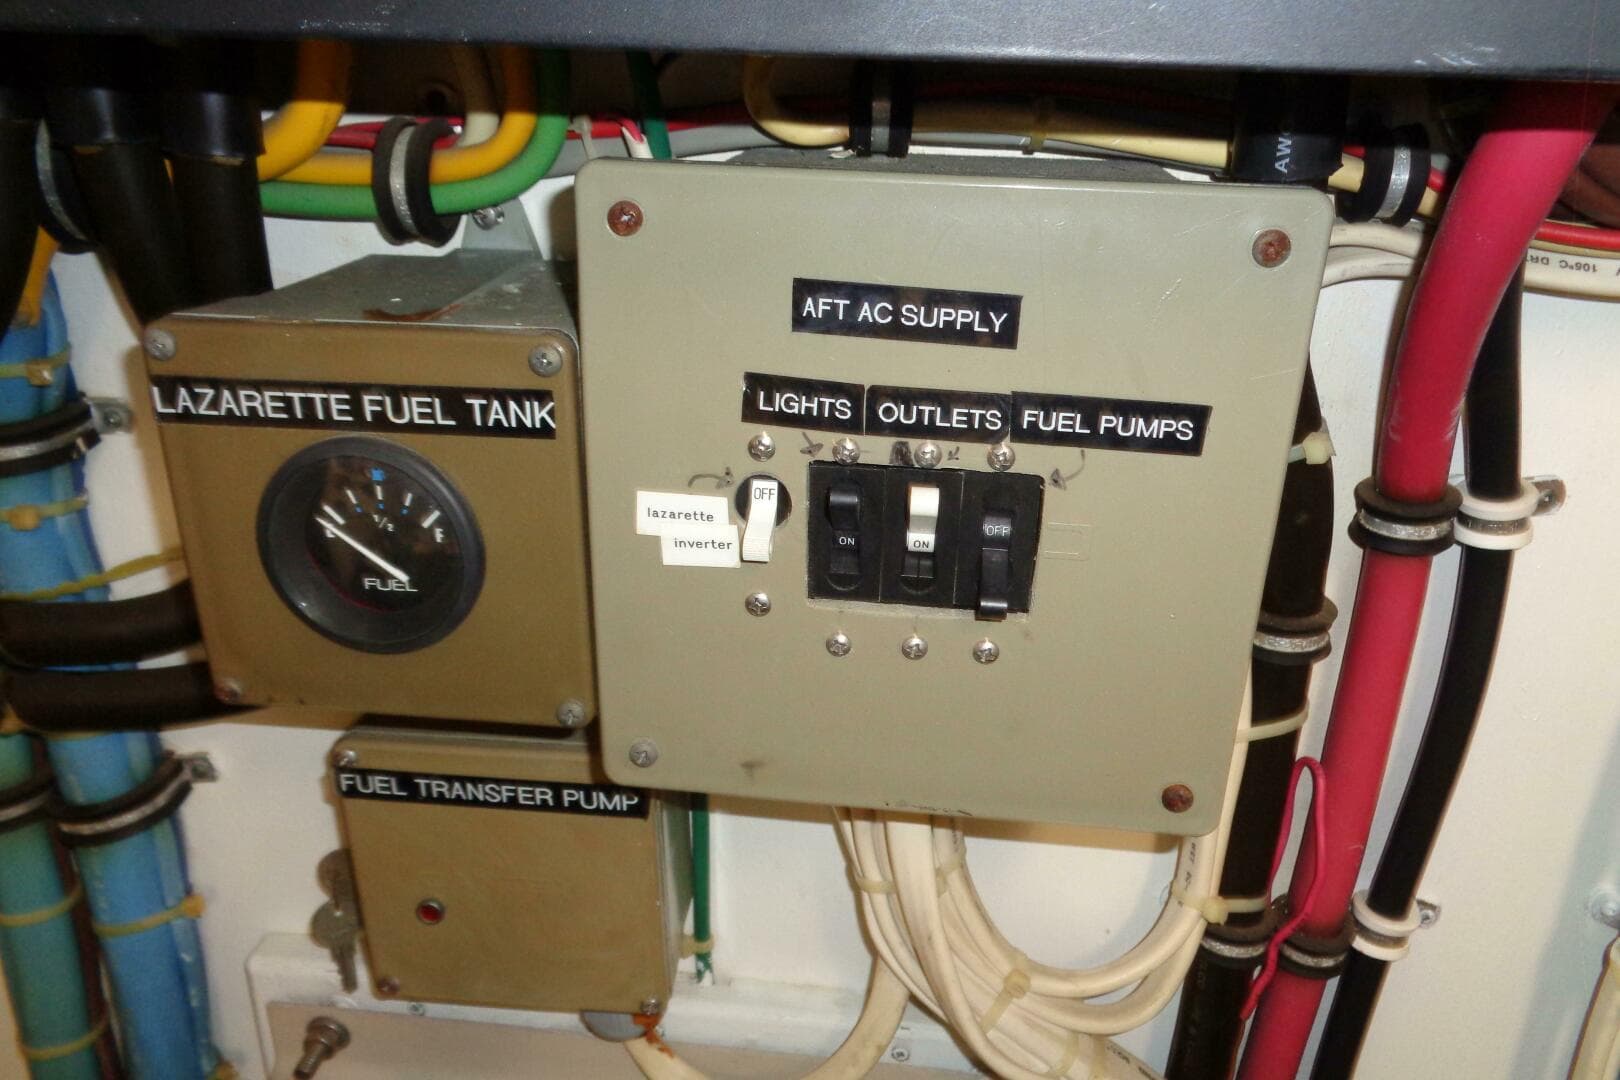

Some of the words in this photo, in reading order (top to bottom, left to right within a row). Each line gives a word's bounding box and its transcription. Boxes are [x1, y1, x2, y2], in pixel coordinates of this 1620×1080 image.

[802, 296, 850, 320] AFT
[857, 301, 894, 324] AC
[901, 304, 1008, 333] SUPPLY
[151, 386, 354, 422] LAZARETTE
[362, 394, 456, 426] FUEL
[465, 398, 557, 429] TANK
[759, 391, 852, 420] LIGHTS
[878, 402, 1002, 431] OUTLETS
[1022, 410, 1091, 434] FUEL
[1099, 415, 1194, 441] PUMPS
[753, 487, 776, 501] OFF
[647, 506, 715, 522] lazarette
[985, 525, 1010, 537] OFF
[674, 537, 733, 550] inverter
[838, 535, 856, 546] ON
[913, 539, 930, 549] ON
[364, 578, 419, 592] FUEL
[339, 773, 408, 797] FUEL
[415, 778, 554, 807] TRANSFER
[562, 789, 639, 812] PUMP
